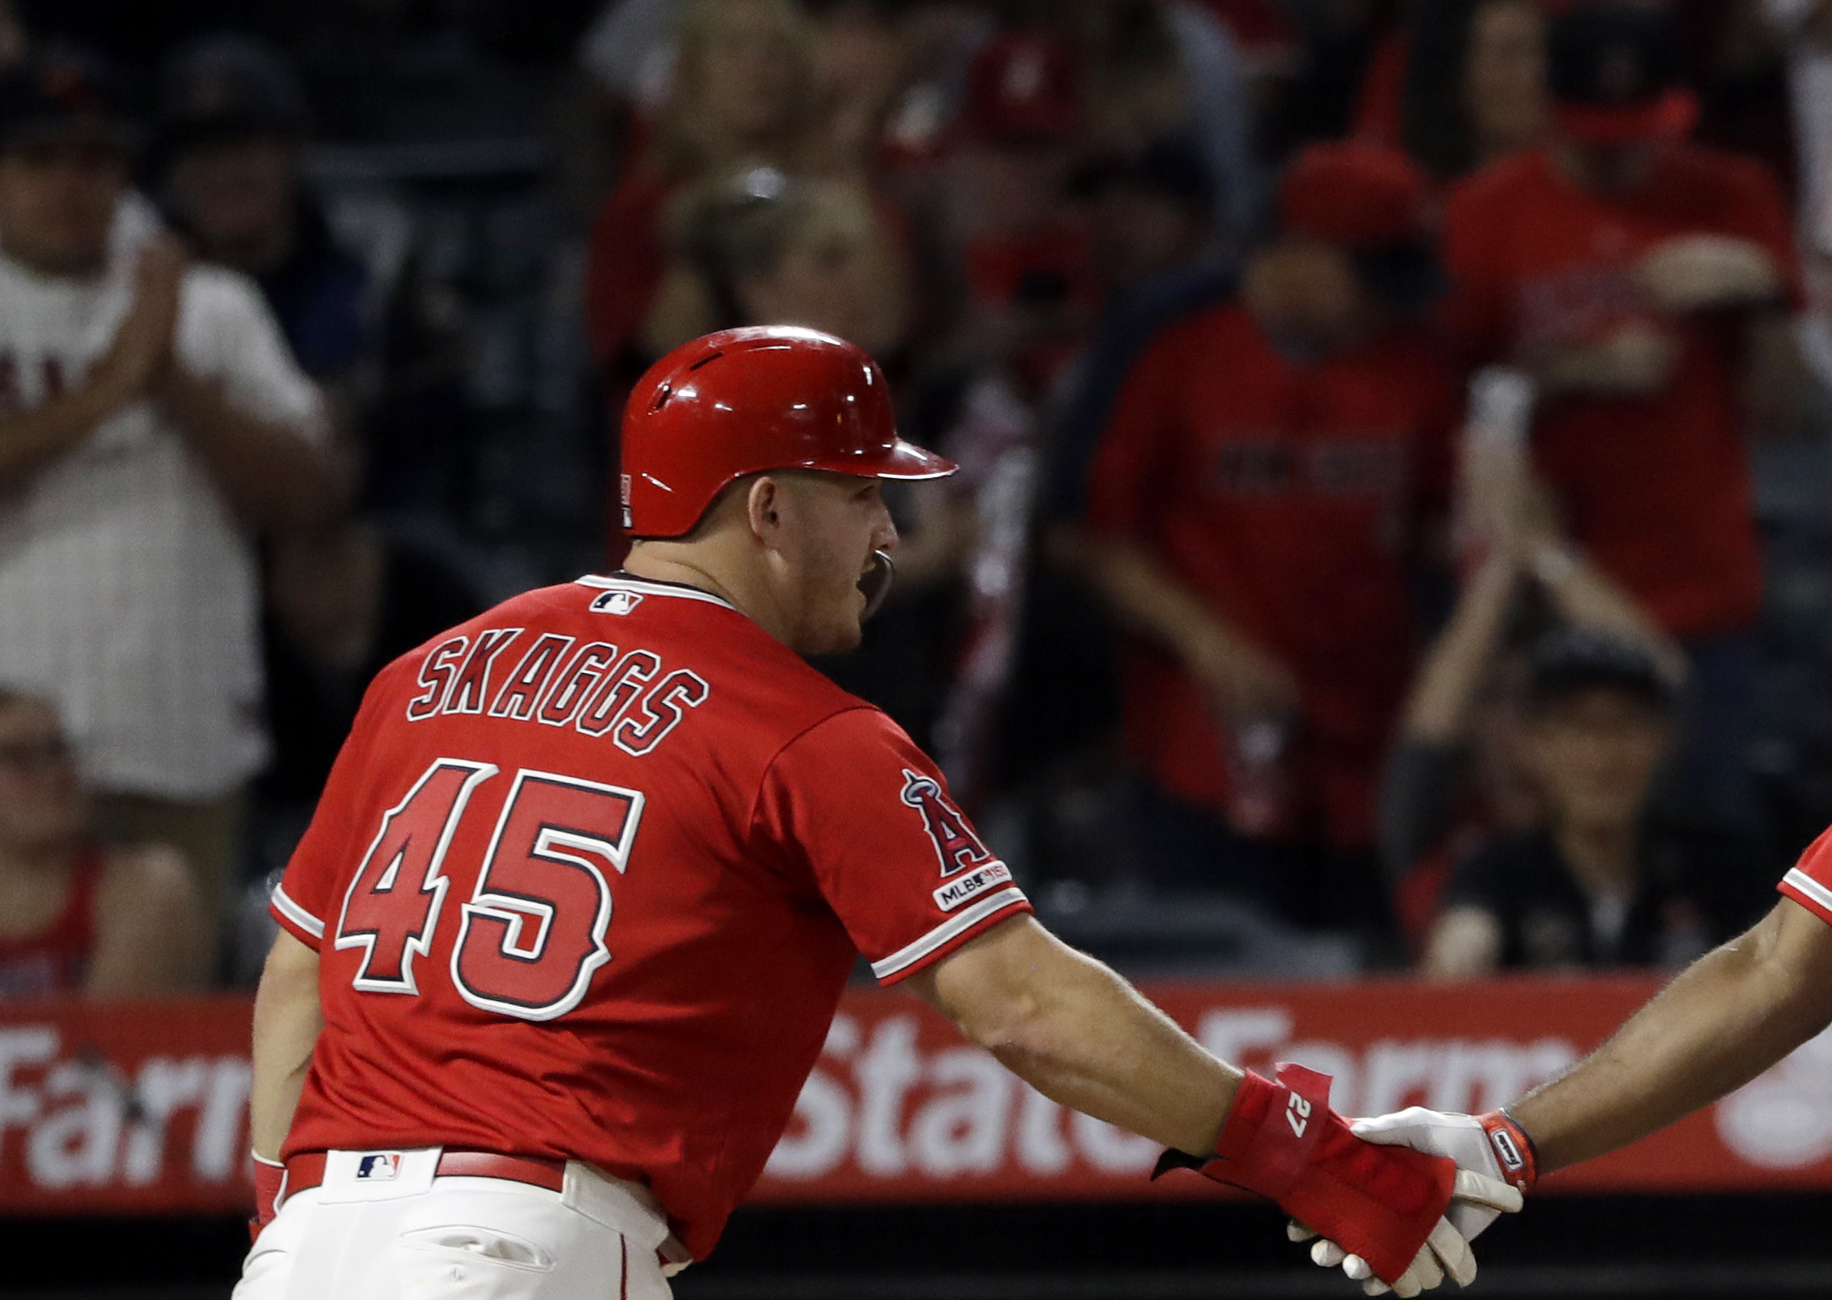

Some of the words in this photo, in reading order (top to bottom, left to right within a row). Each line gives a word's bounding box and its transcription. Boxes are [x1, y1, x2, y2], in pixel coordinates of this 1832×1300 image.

[406, 628, 709, 756] SKAGGS
[900, 768, 991, 878] A
[334, 756, 646, 1022] 45
[941, 879, 976, 905] MLB
[1285, 1090, 1312, 1139] 27
